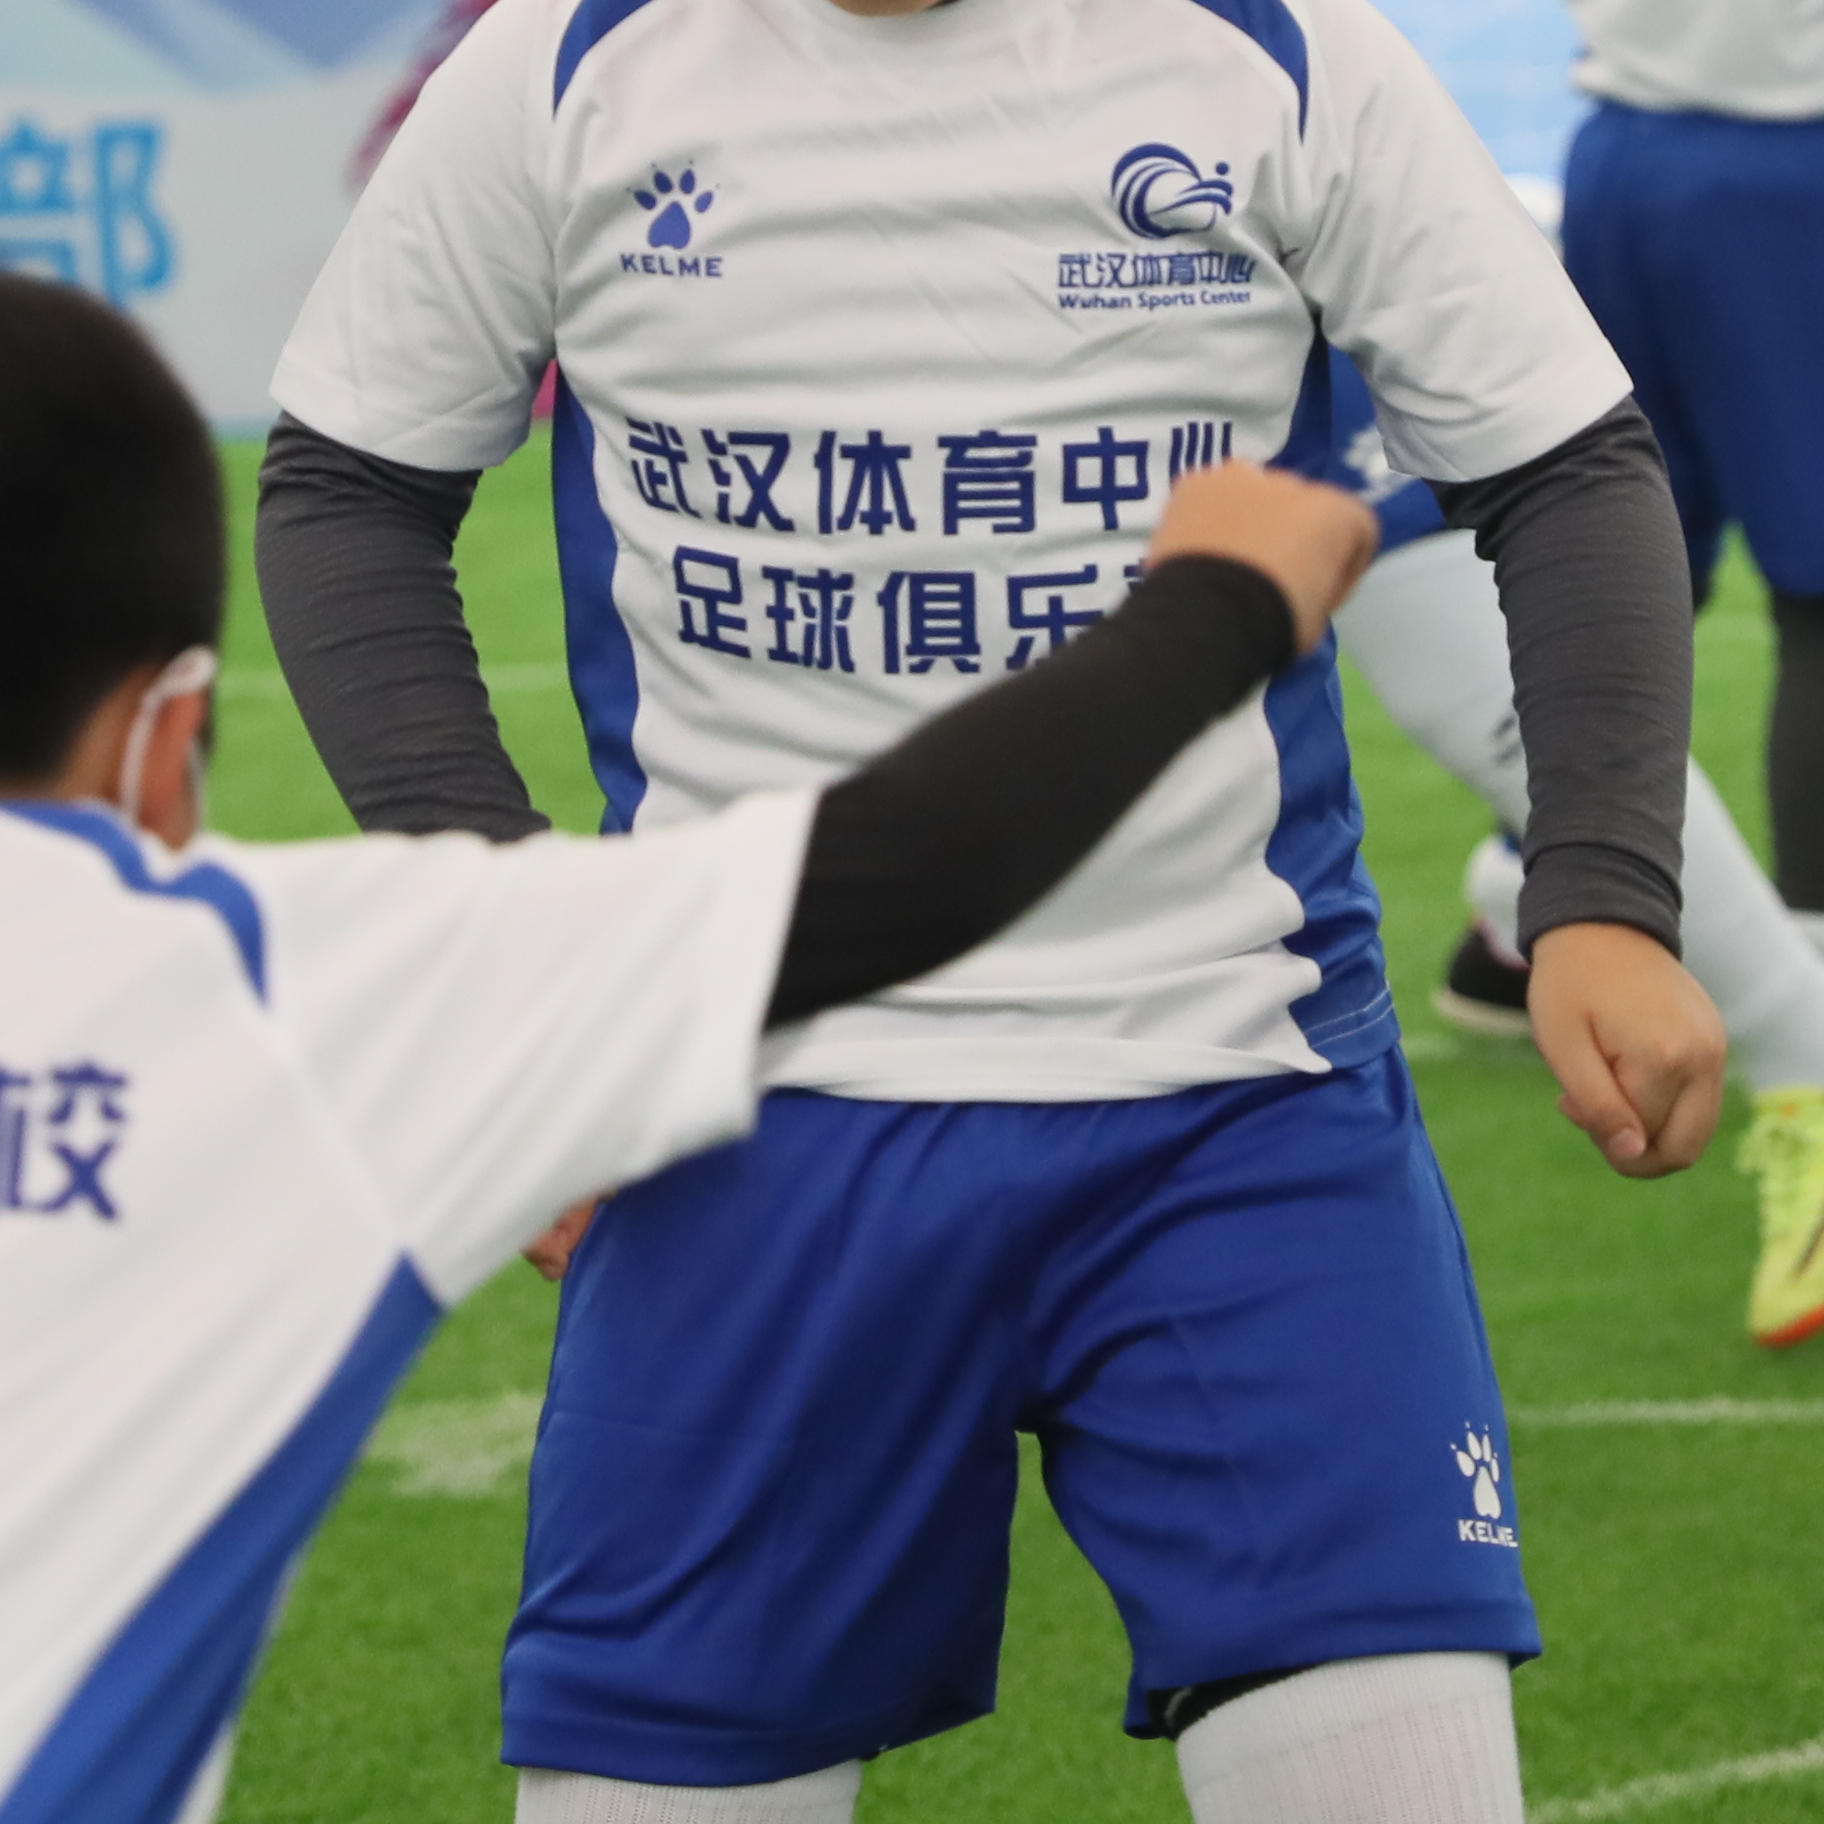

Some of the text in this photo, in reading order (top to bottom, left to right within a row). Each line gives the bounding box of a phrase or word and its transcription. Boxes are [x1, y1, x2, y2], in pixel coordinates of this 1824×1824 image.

[620, 252, 723, 278] KELME
[1057, 251, 1255, 288] 武汉体育中心
[1058, 289, 1251, 312] Wuhan Sports Center
[674, 544, 1146, 675] 足球俱乐
